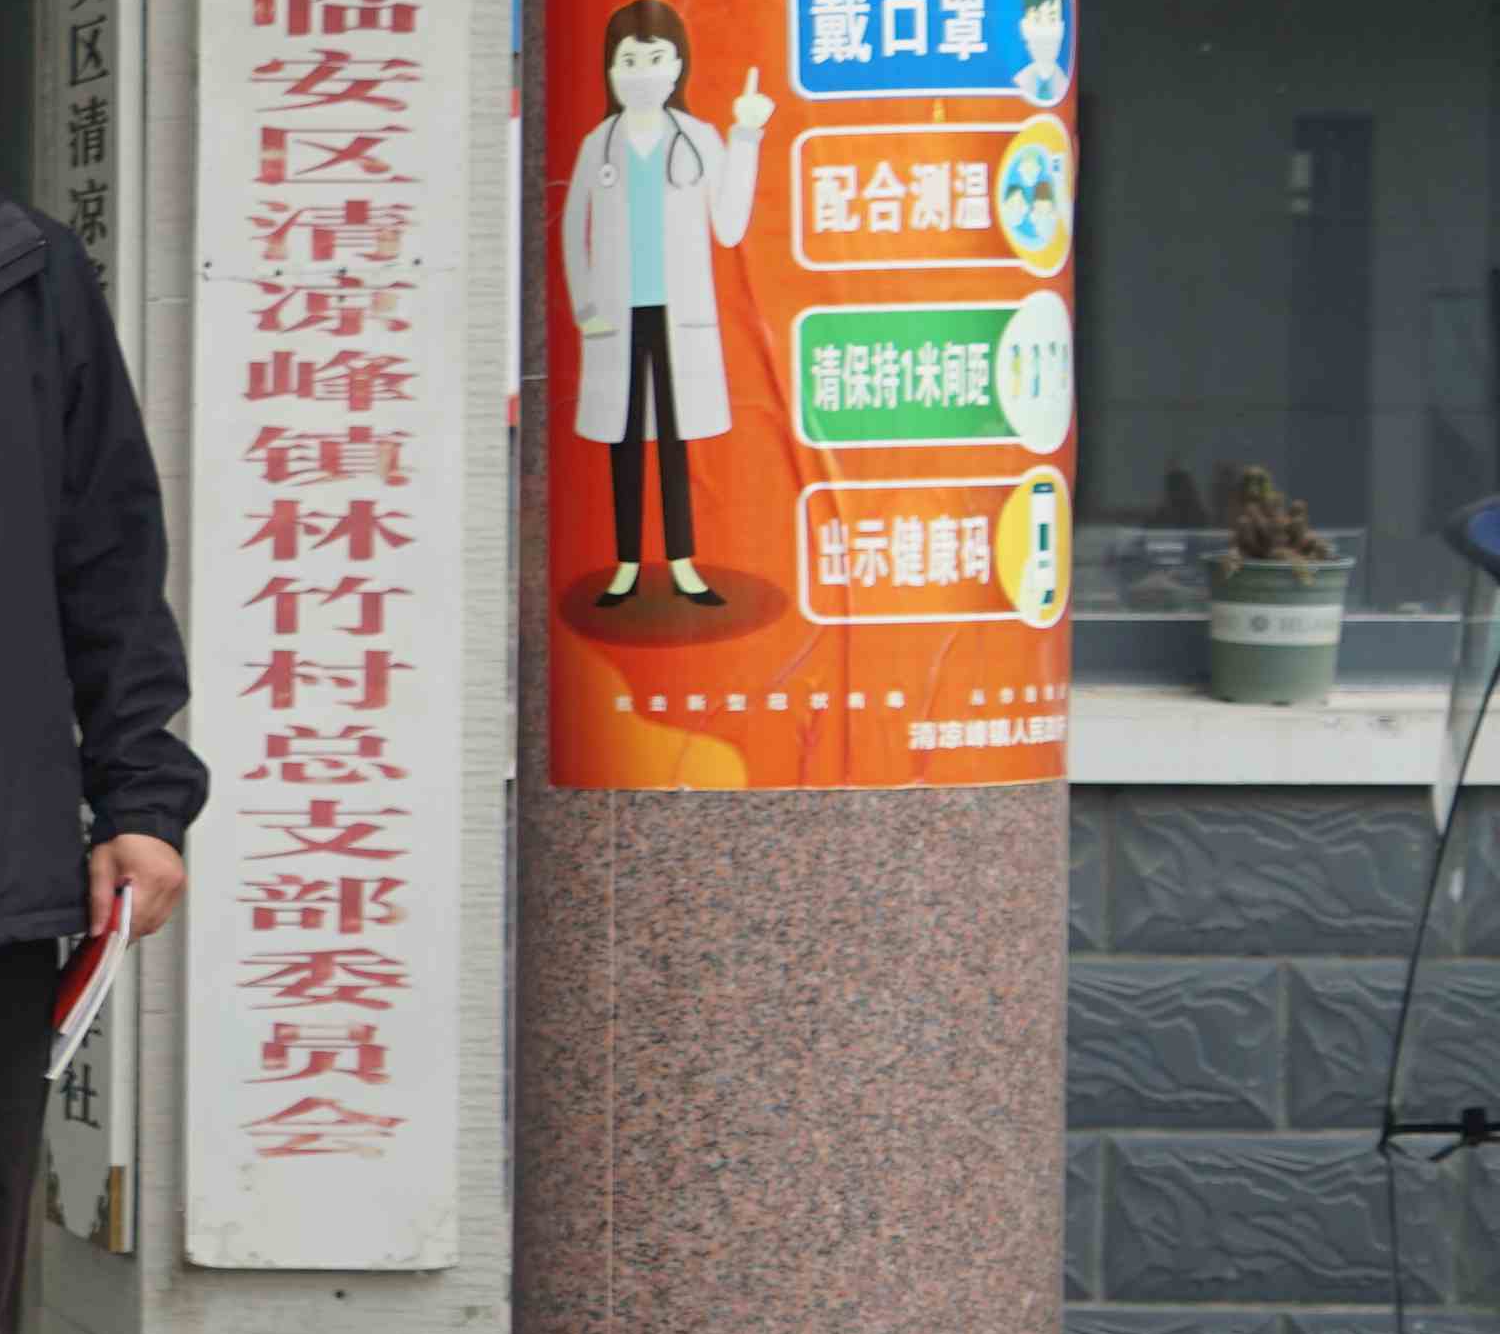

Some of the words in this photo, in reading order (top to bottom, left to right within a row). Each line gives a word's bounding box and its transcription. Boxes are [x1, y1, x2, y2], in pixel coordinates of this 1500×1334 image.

[812, 160, 992, 234] 配合测温
[811, 341, 991, 414] 请保持1米间距
[818, 514, 992, 588] 出示健康码
